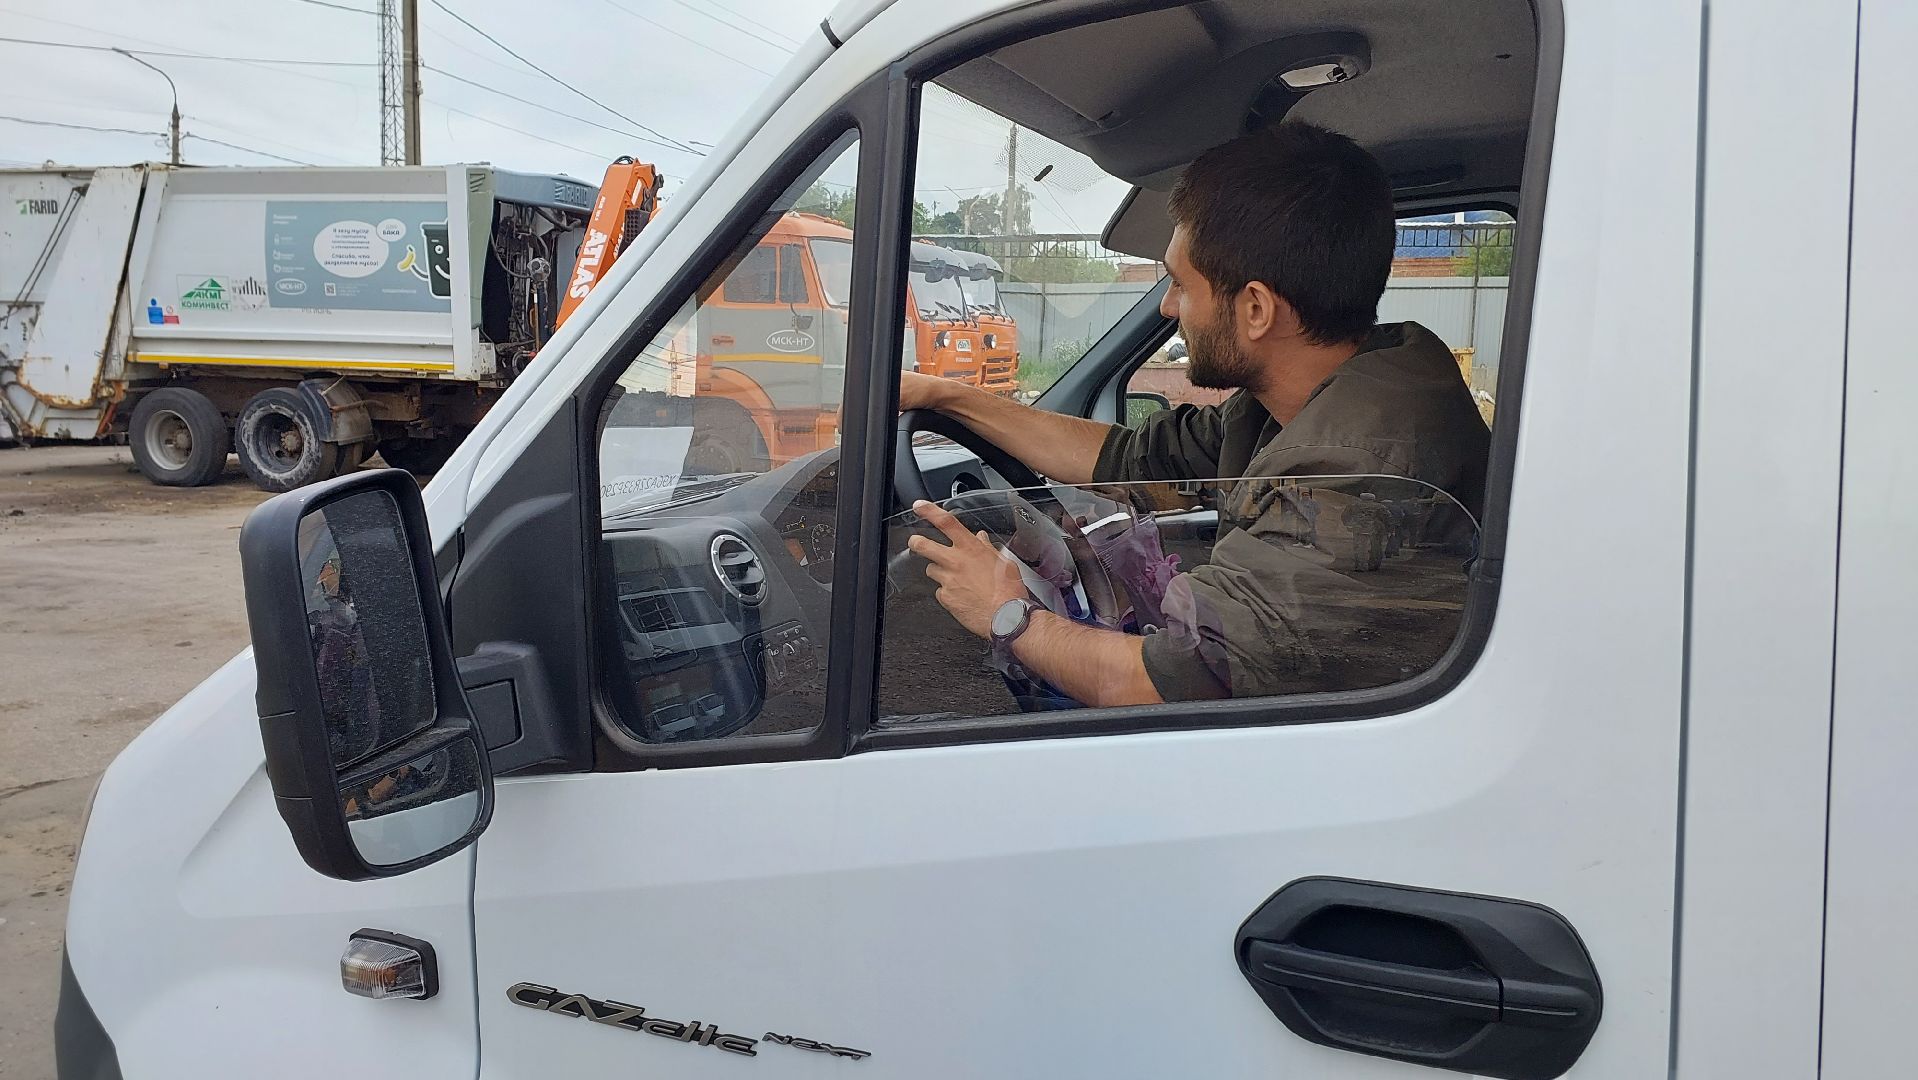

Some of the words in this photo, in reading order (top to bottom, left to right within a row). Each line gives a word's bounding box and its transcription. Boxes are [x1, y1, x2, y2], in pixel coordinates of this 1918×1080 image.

[29, 200, 58, 214] FARID
[570, 229, 607, 298] ATLAS
[181, 301, 229, 310] КОМИНВЕСТ
[771, 337, 809, 346] МСК-НТ
